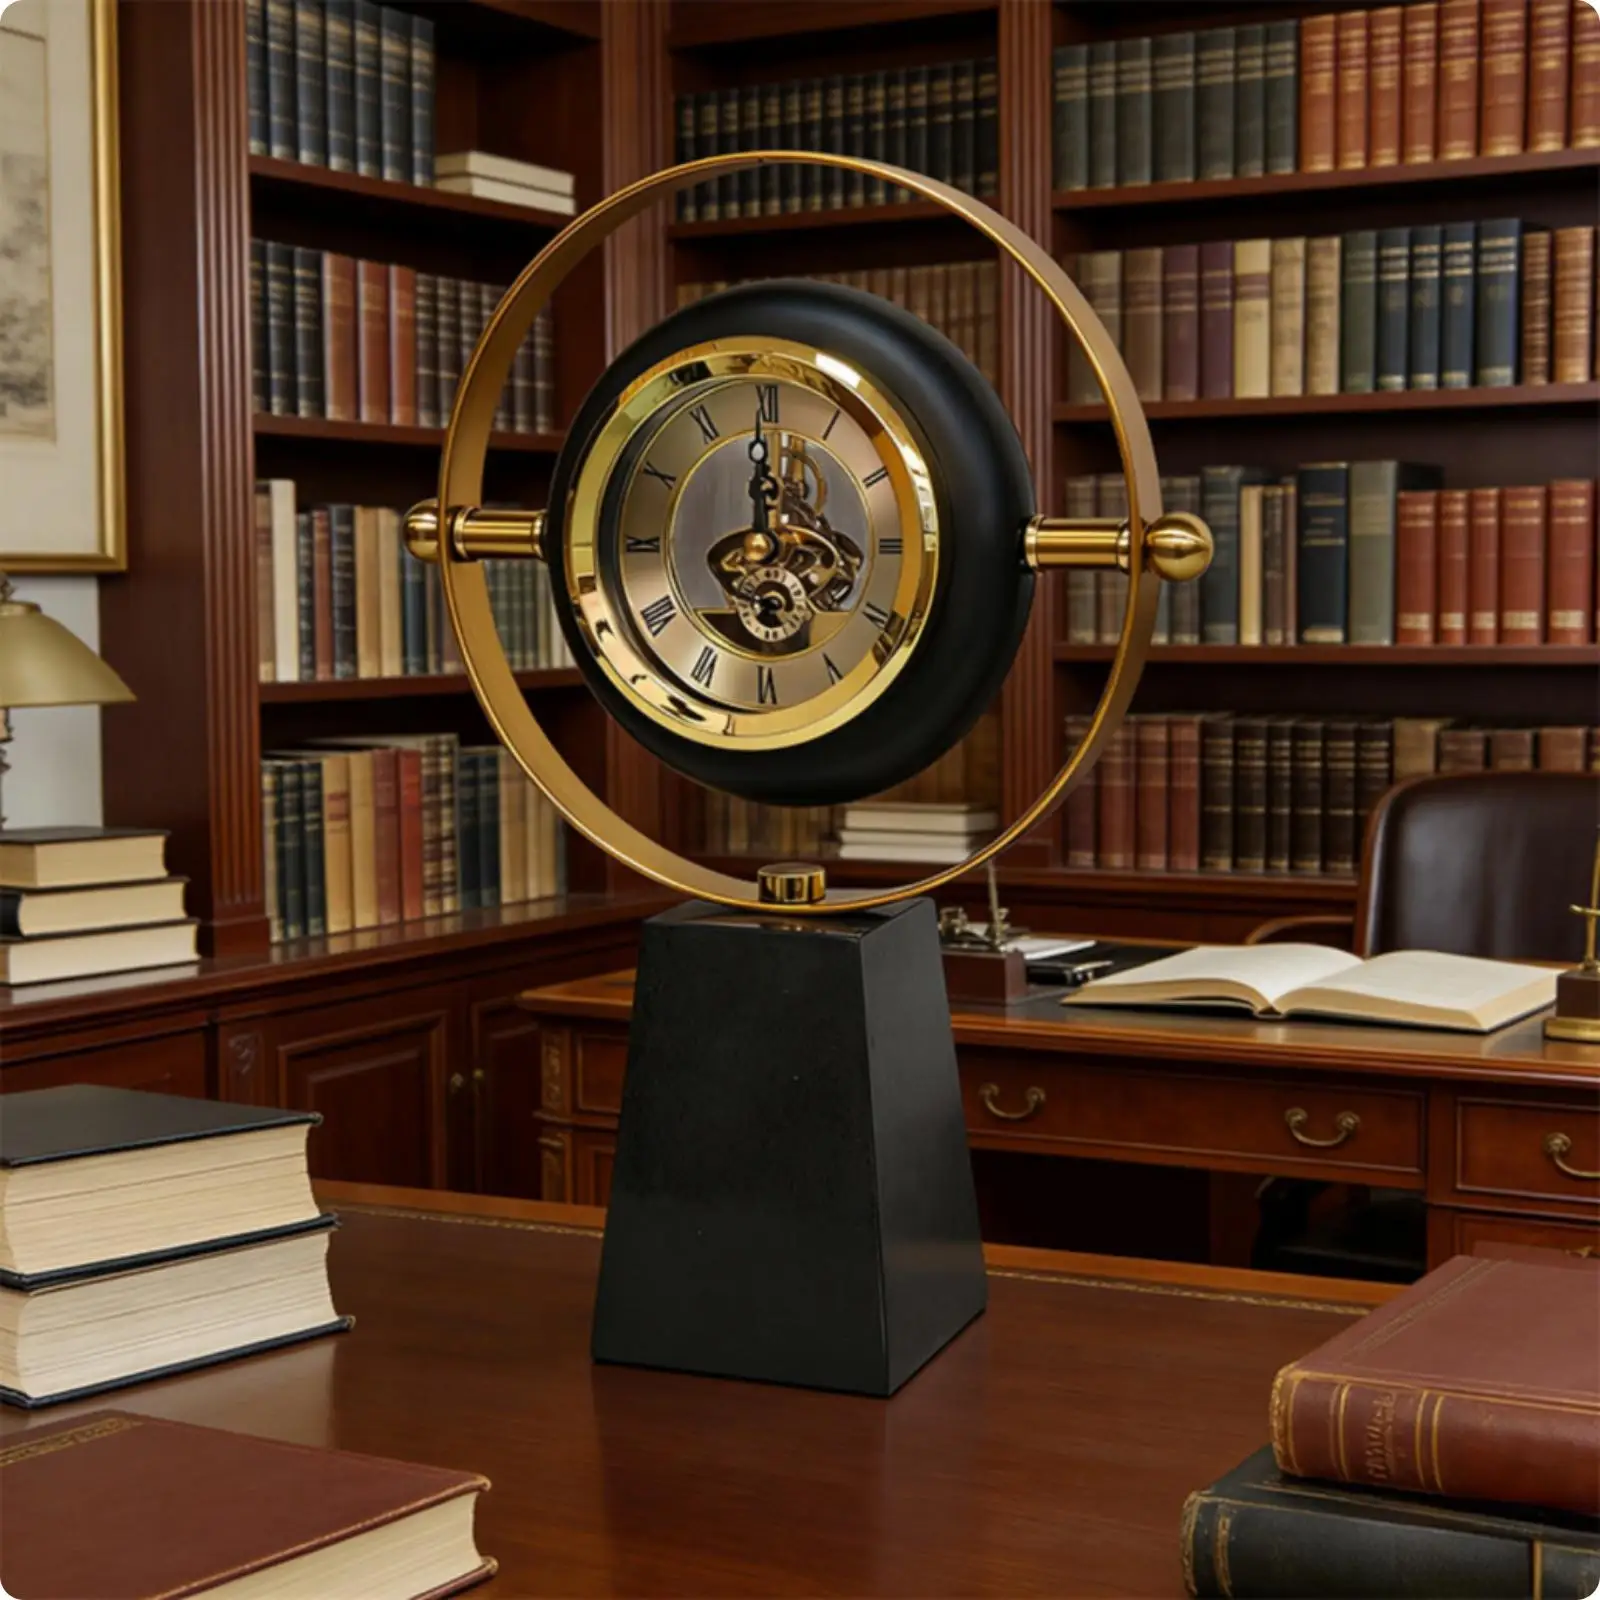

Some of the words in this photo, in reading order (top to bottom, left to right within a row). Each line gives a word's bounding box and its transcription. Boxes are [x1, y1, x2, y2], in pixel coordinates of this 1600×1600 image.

[755, 384, 779, 423] XII
[690, 404, 720, 444] XI
[822, 410, 841, 441] I
[643, 461, 677, 490] X
[862, 466, 889, 488] II
[626, 535, 660, 552] IX
[879, 538, 904, 555] III
[822, 652, 844, 686] V
[757, 665, 777, 705] VI
